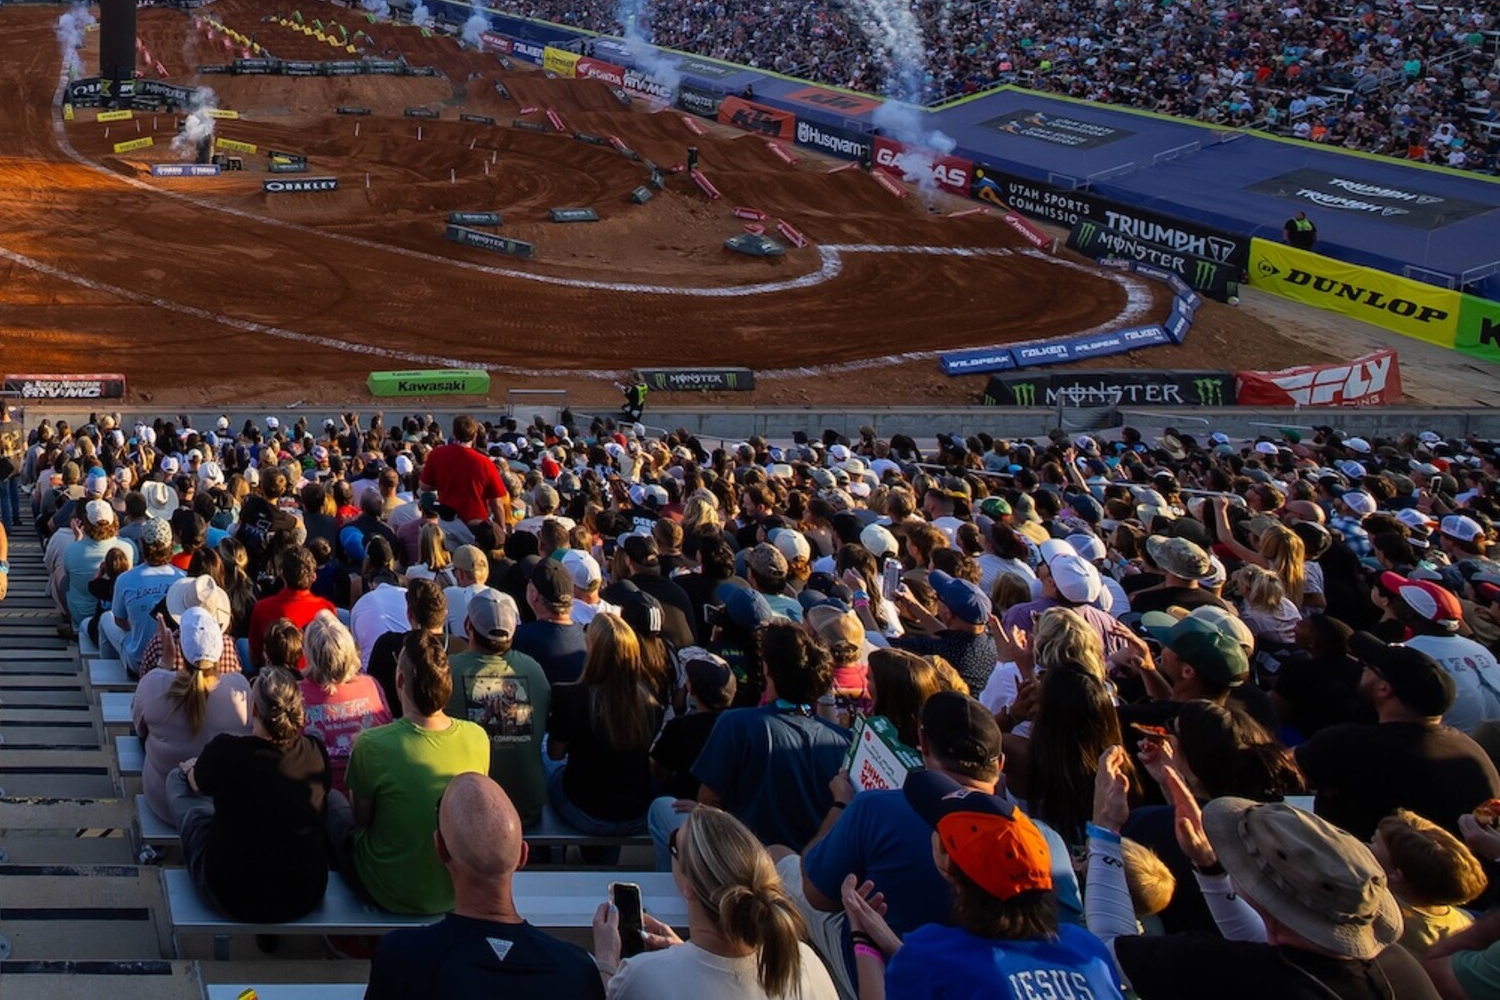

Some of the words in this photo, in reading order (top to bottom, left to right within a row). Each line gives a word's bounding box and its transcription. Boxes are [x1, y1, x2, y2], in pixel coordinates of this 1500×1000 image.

[513, 42, 543, 58] FALKEN
[588, 68, 622, 86] HONDA
[731, 108, 782, 137] KTM
[1009, 183, 1040, 198] UTAH
[1042, 189, 1091, 215] SPORTS
[1329, 177, 1418, 201] TRIUMPH
[1008, 195, 1078, 225] COMMISSIO
[1297, 187, 1381, 216] TRIUMPH
[468, 232, 505, 248] MONSTER
[1016, 223, 1043, 245] HONDA
[1105, 211, 1206, 255] TRIUMPH
[1097, 230, 1185, 273] MONSTER
[1283, 267, 1449, 323] DUNLOP
[1074, 338, 1120, 352] WILDPEAK
[1124, 327, 1162, 341] FALKEN
[950, 354, 1010, 368] WILDPEAK
[1021, 345, 1067, 358] FALKEN
[398, 379, 467, 393] Kawasaki
[669, 373, 723, 386] MONSTER
[1272, 356, 1393, 405] FLY
[1045, 382, 1185, 407] MONSTER
[1008, 969, 1095, 1000] JESUS
